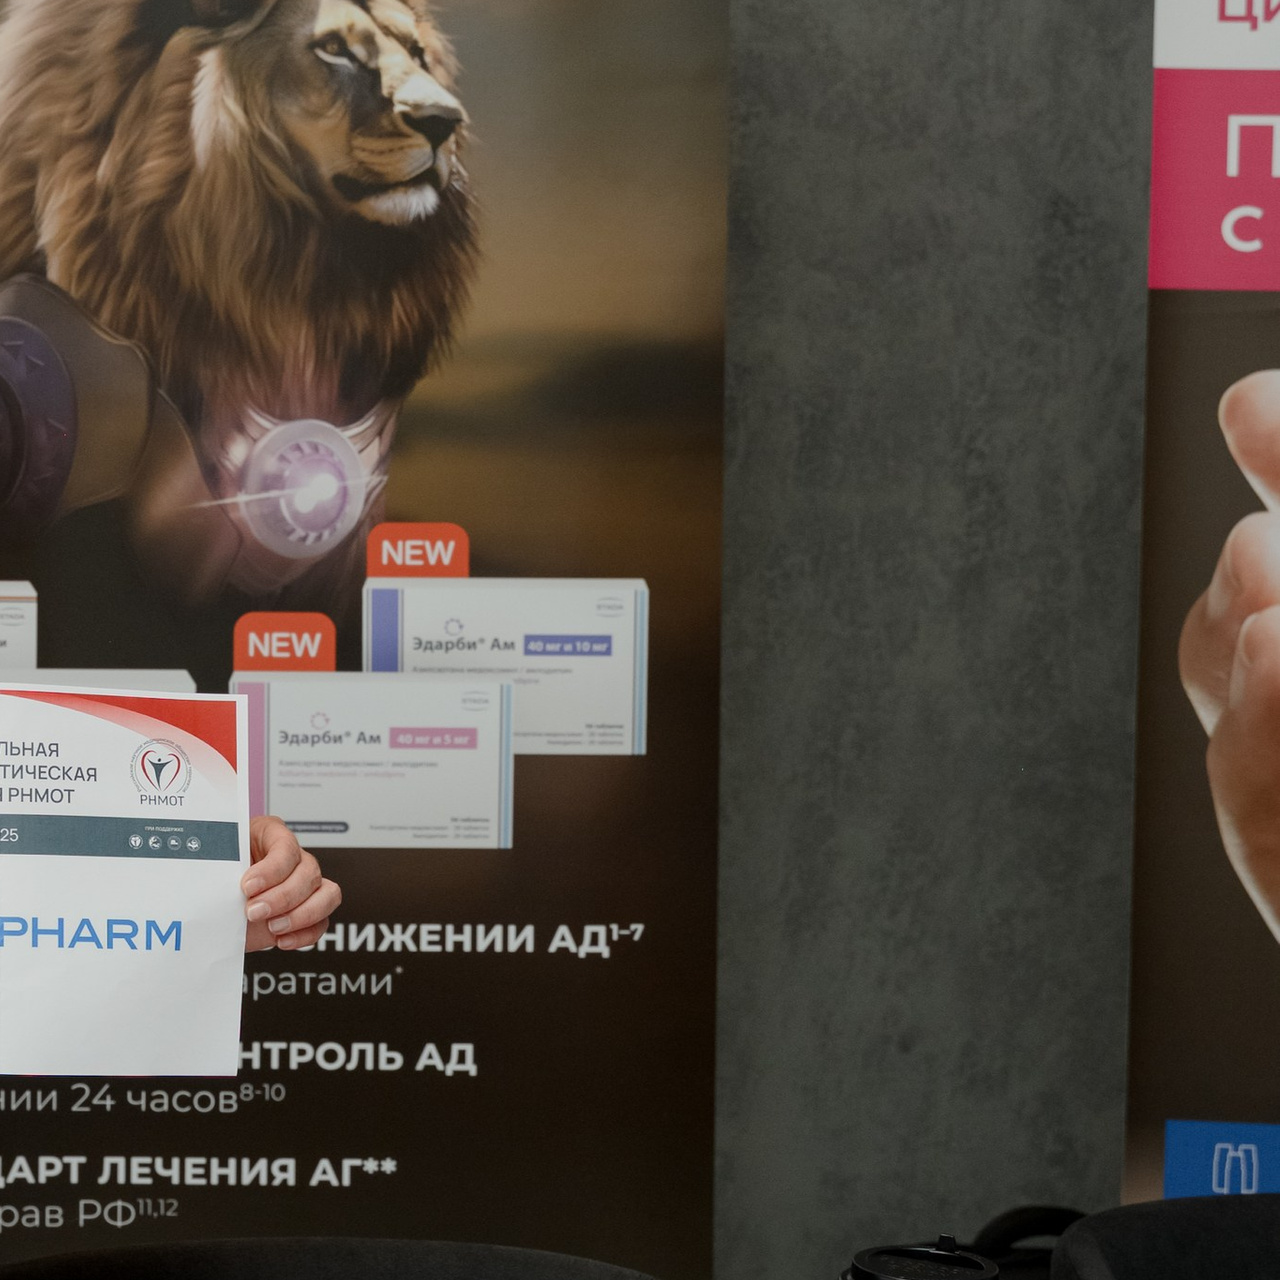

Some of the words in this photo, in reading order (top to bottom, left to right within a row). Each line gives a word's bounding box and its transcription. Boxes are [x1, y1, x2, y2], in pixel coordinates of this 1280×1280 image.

[381, 539, 456, 566] NEW
[247, 631, 322, 658] NEW
[490, 637, 516, 651] Ам
[356, 731, 382, 745] Ам
[6, 786, 76, 805] РНМОТ
[140, 794, 185, 807] РНМОТ
[296, 922, 537, 953] НИЖЕНИИ
[415, 1042, 479, 1077] АД
[70, 1083, 117, 1113] 24
[98, 1155, 297, 1188] ЛЕЧЕНИЯ
